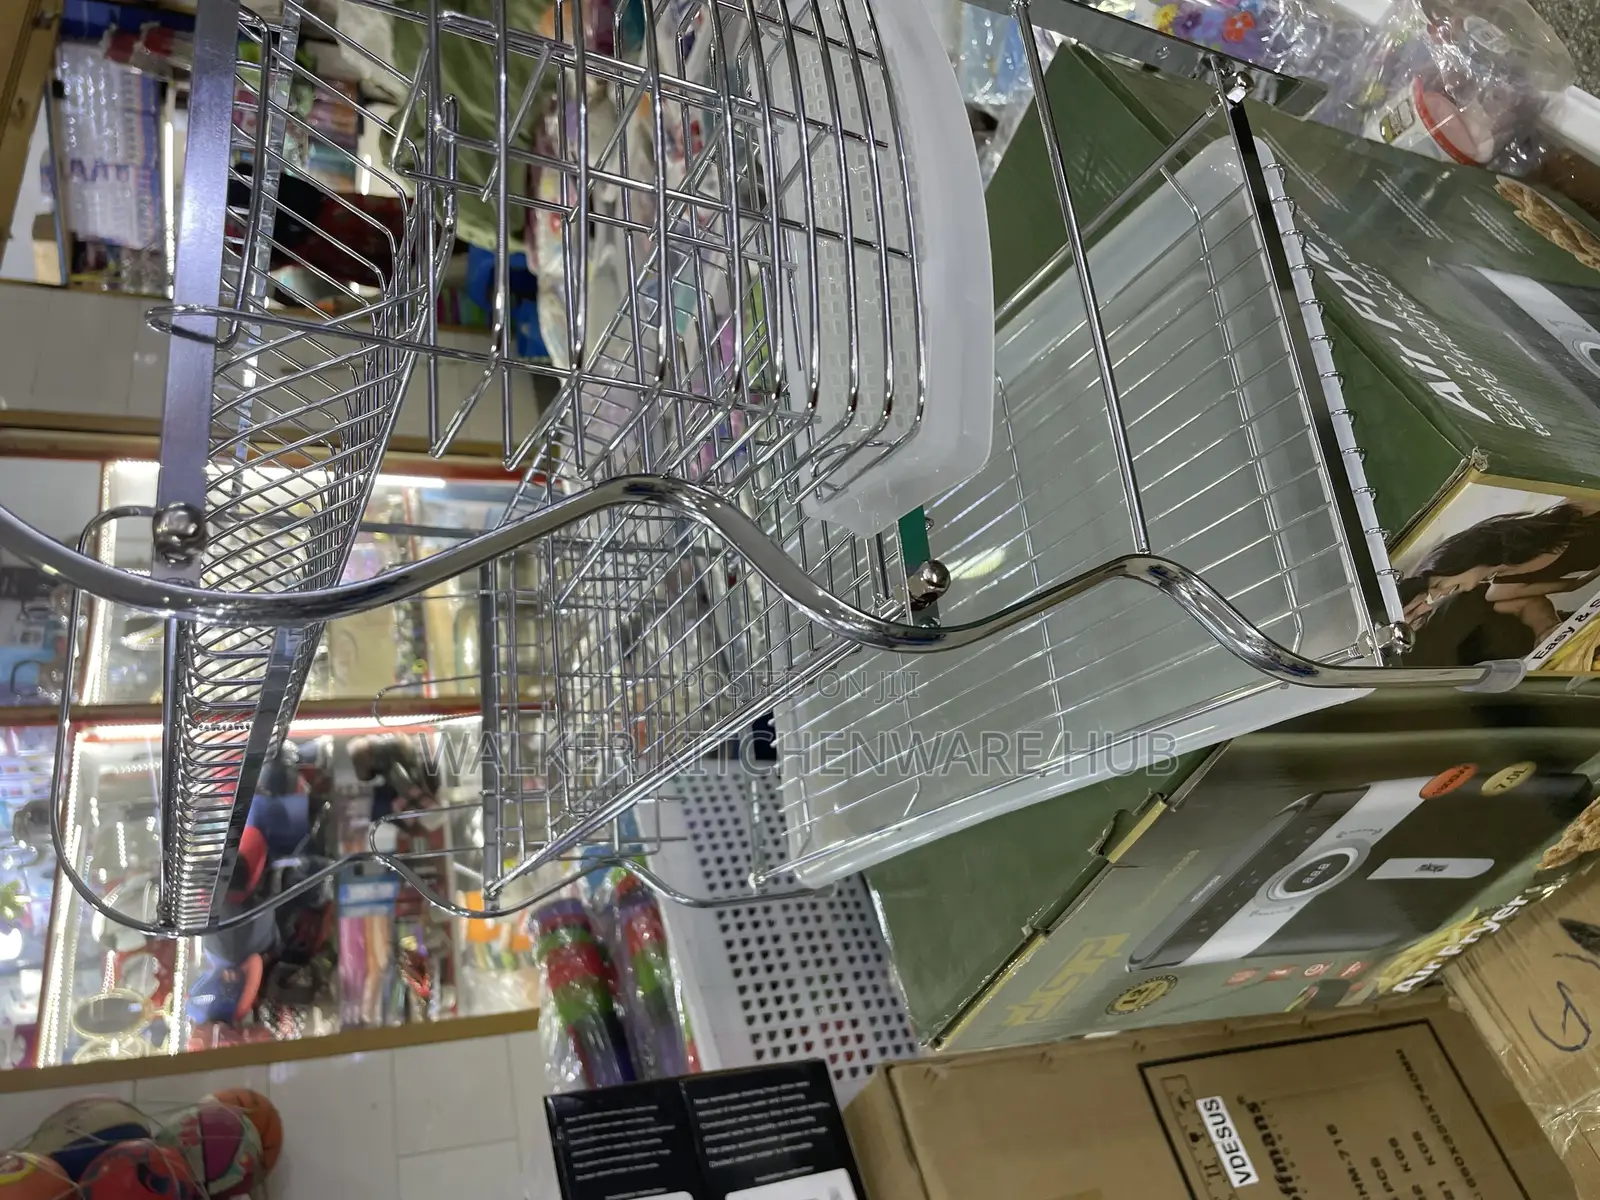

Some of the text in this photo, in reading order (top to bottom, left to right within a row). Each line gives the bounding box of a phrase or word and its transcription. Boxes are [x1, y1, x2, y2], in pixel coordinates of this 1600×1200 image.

[1303, 238, 1403, 332] Frye
[1333, 247, 1388, 297] more
[1360, 262, 1551, 436] tasting fried food!
[1384, 298, 1446, 352] make
[1389, 336, 1495, 424] Air
[1443, 355, 1472, 377] to
[1468, 379, 1526, 430] Easy
[1532, 626, 1575, 660] Easy
[1393, 895, 1528, 992] Air Fryer
[1204, 1098, 1252, 1184] VDESUS
